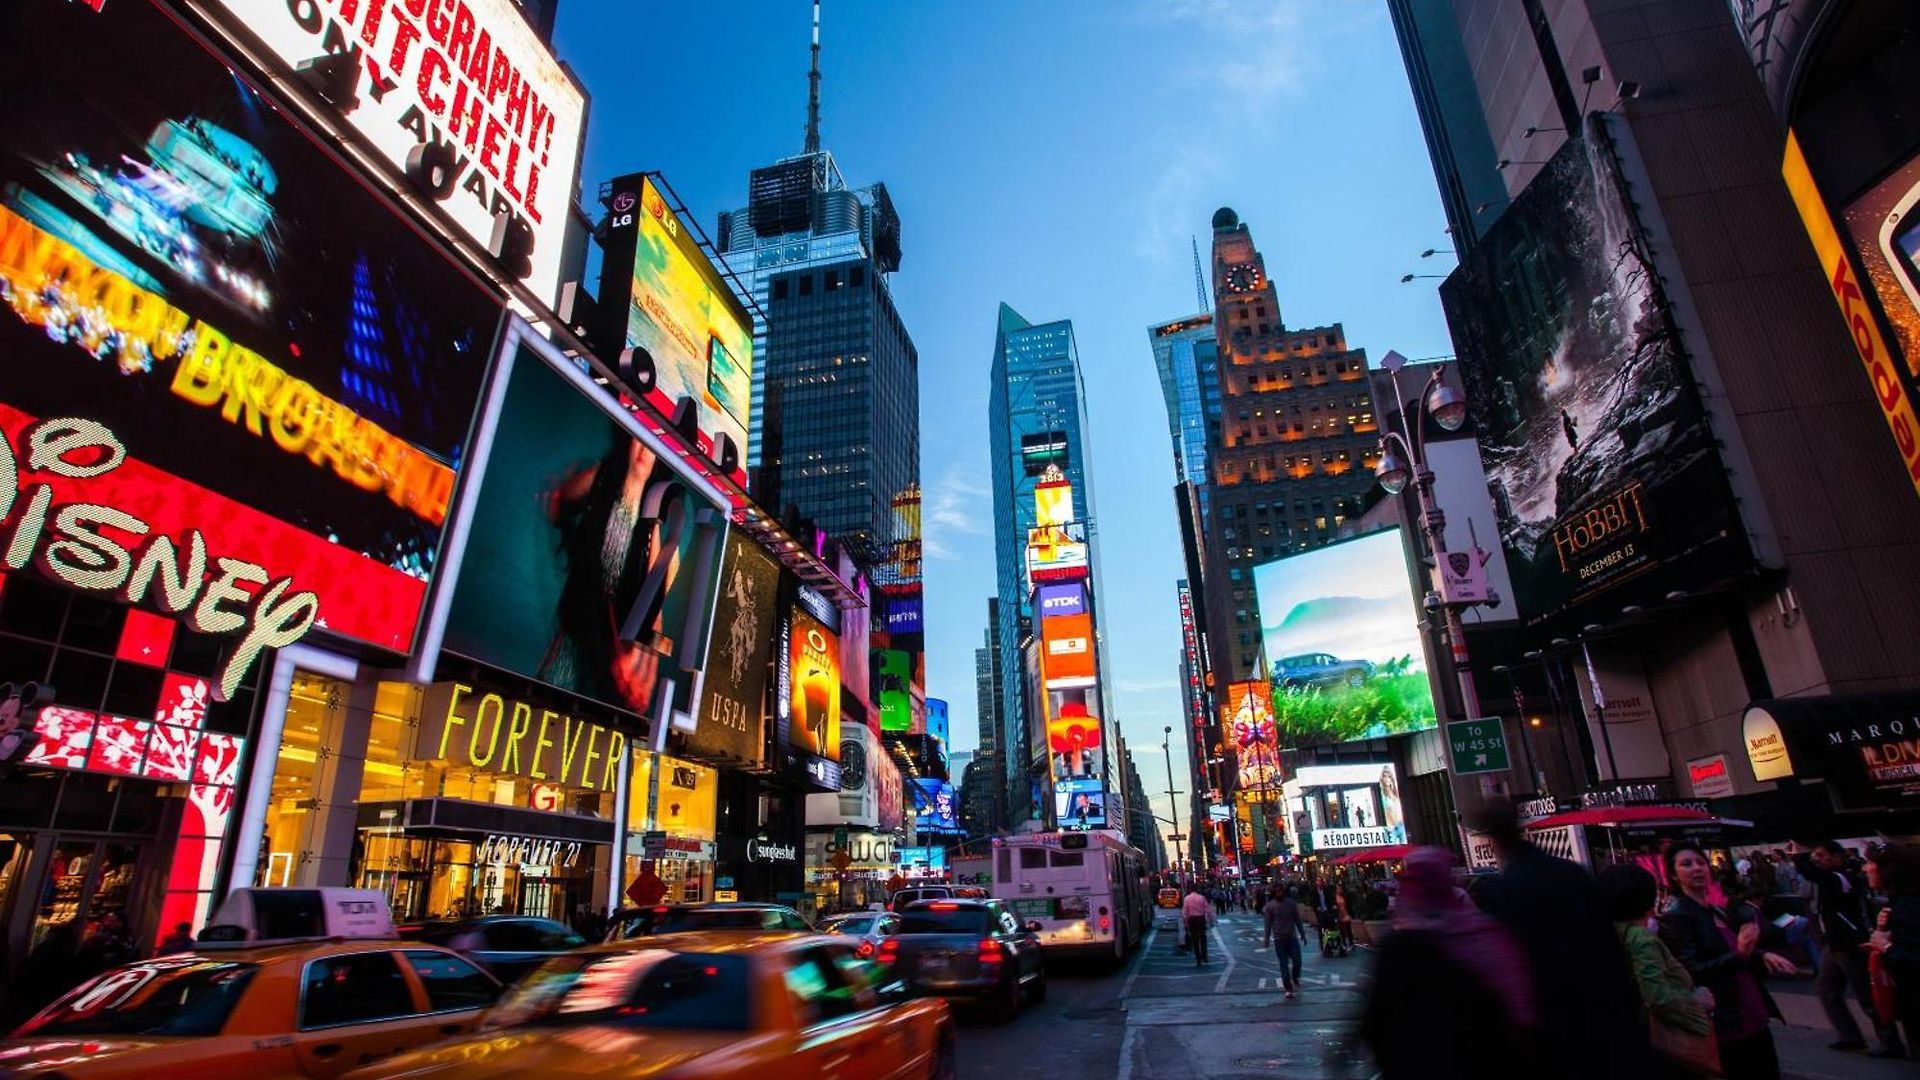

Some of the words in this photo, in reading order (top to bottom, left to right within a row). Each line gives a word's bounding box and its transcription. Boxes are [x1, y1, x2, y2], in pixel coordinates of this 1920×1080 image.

[612, 214, 632, 228] LG
[662, 218, 678, 238] LG
[1832, 258, 1920, 486] Koda
[1551, 481, 1651, 576] HOBBIT
[1579, 550, 1625, 580] DECEMBER
[1624, 543, 1637, 562] 13
[1053, 596, 1081, 609] TDK
[711, 692, 747, 732] USPA
[438, 684, 624, 794] FOREVER
[1453, 742, 1467, 753] W
[1469, 739, 1487, 751] 45
[485, 834, 563, 866] FOREVER
[565, 841, 583, 868] 21
